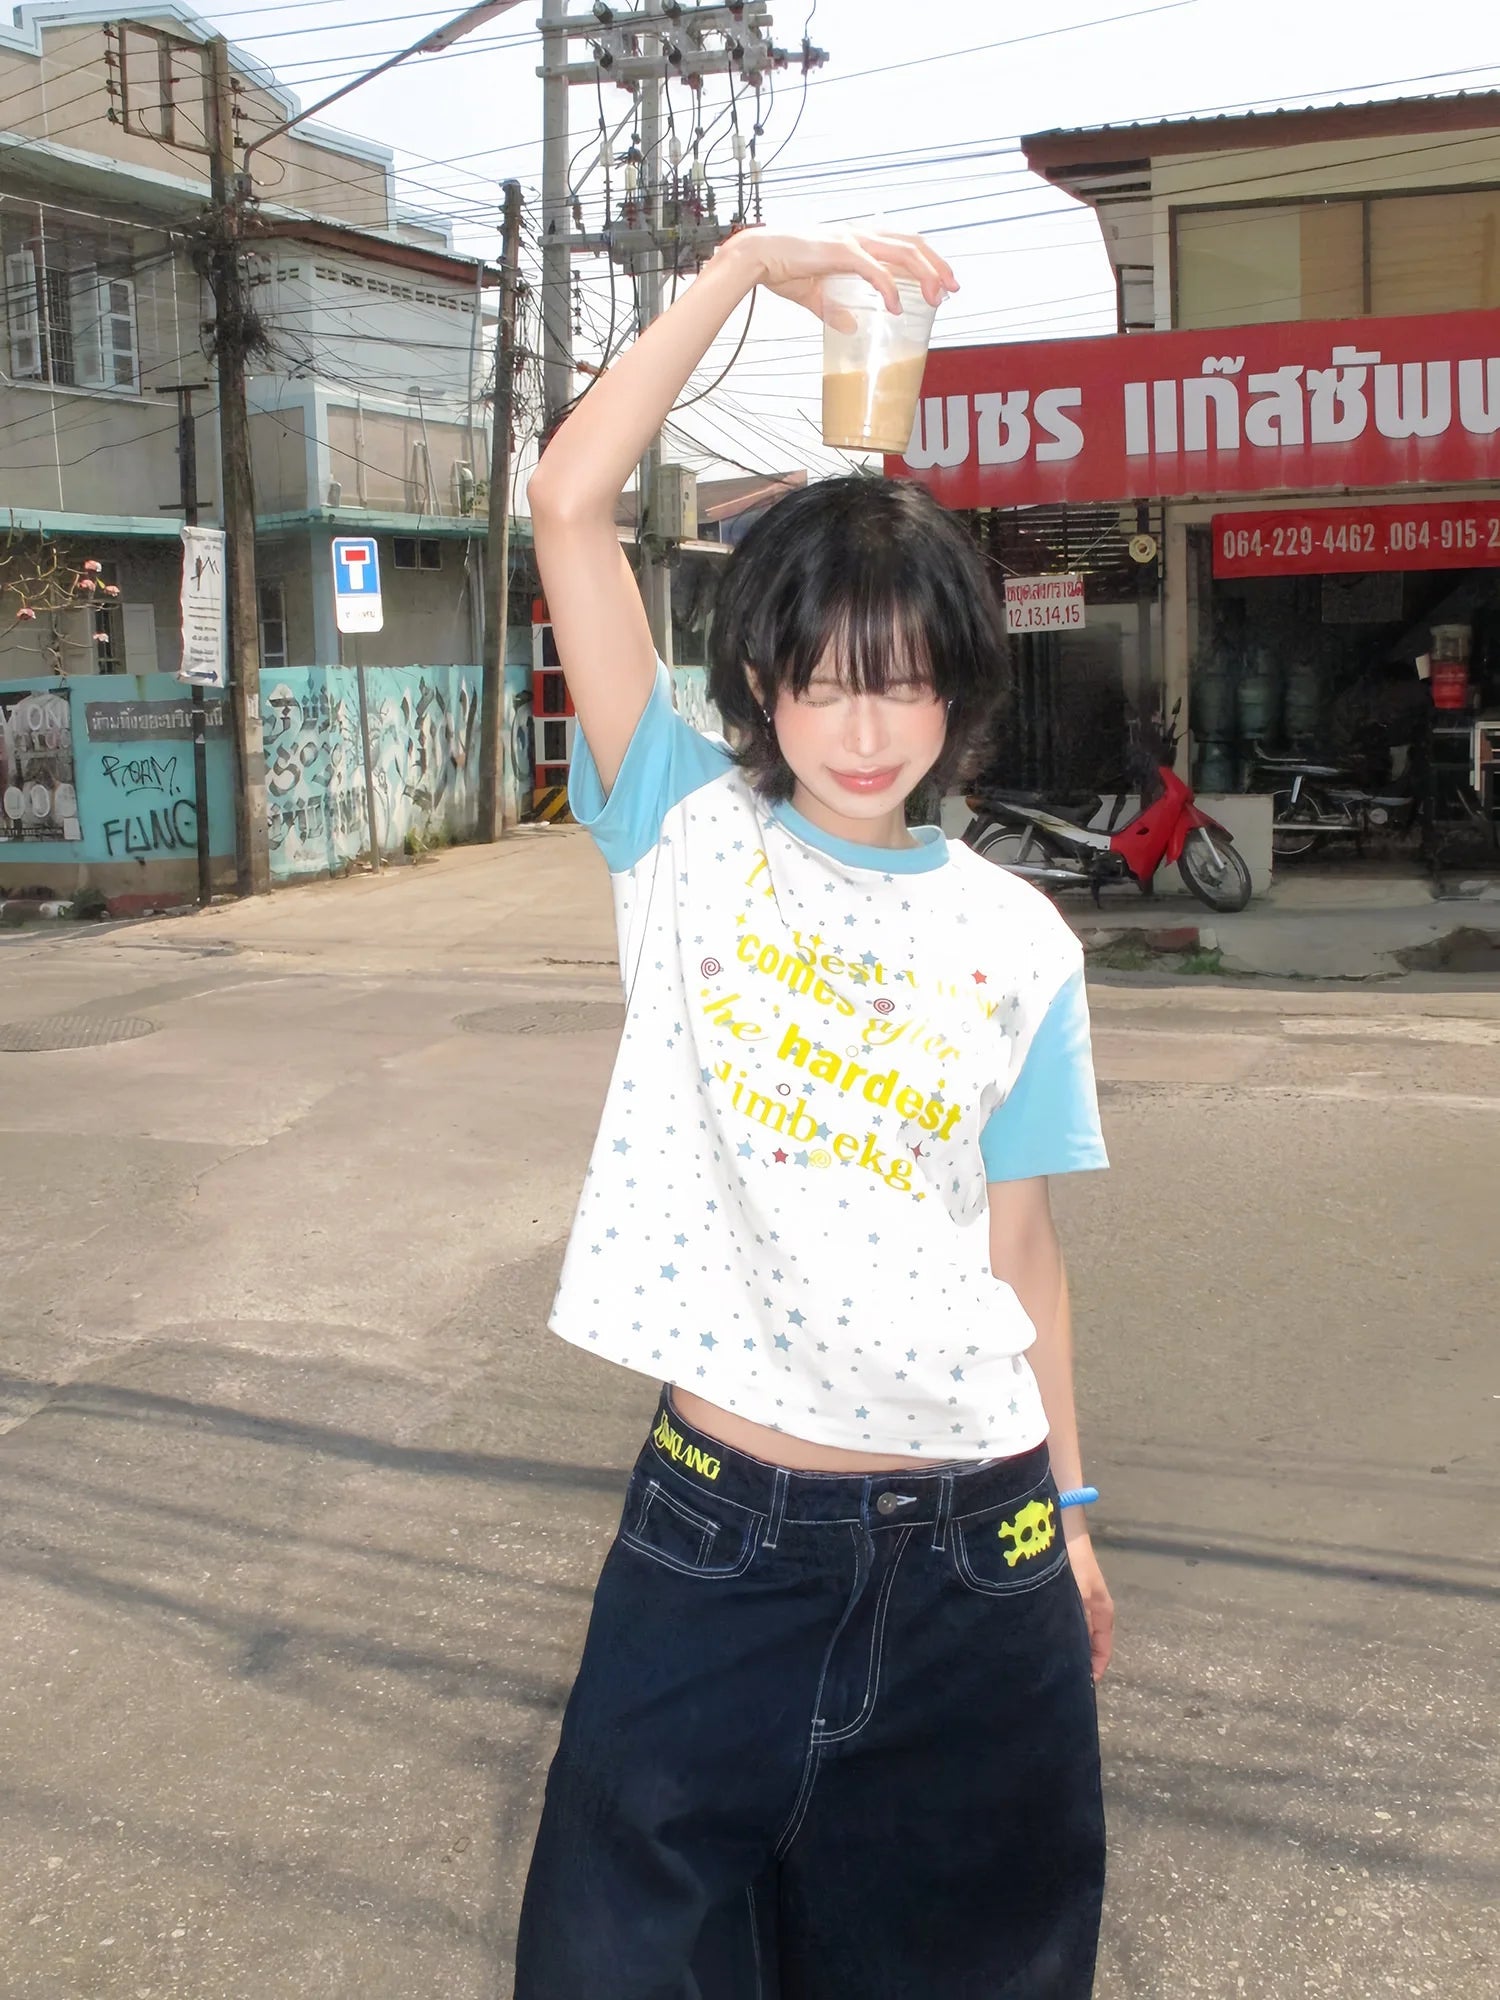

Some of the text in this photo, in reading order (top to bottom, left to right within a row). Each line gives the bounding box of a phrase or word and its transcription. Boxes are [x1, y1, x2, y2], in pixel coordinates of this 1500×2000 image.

[1223, 523, 1376, 559] 064-229-4462
[1009, 604, 1080, 628] 12.13.14.15
[736, 933, 856, 1017] comes
[776, 1023, 963, 1142] hardest
